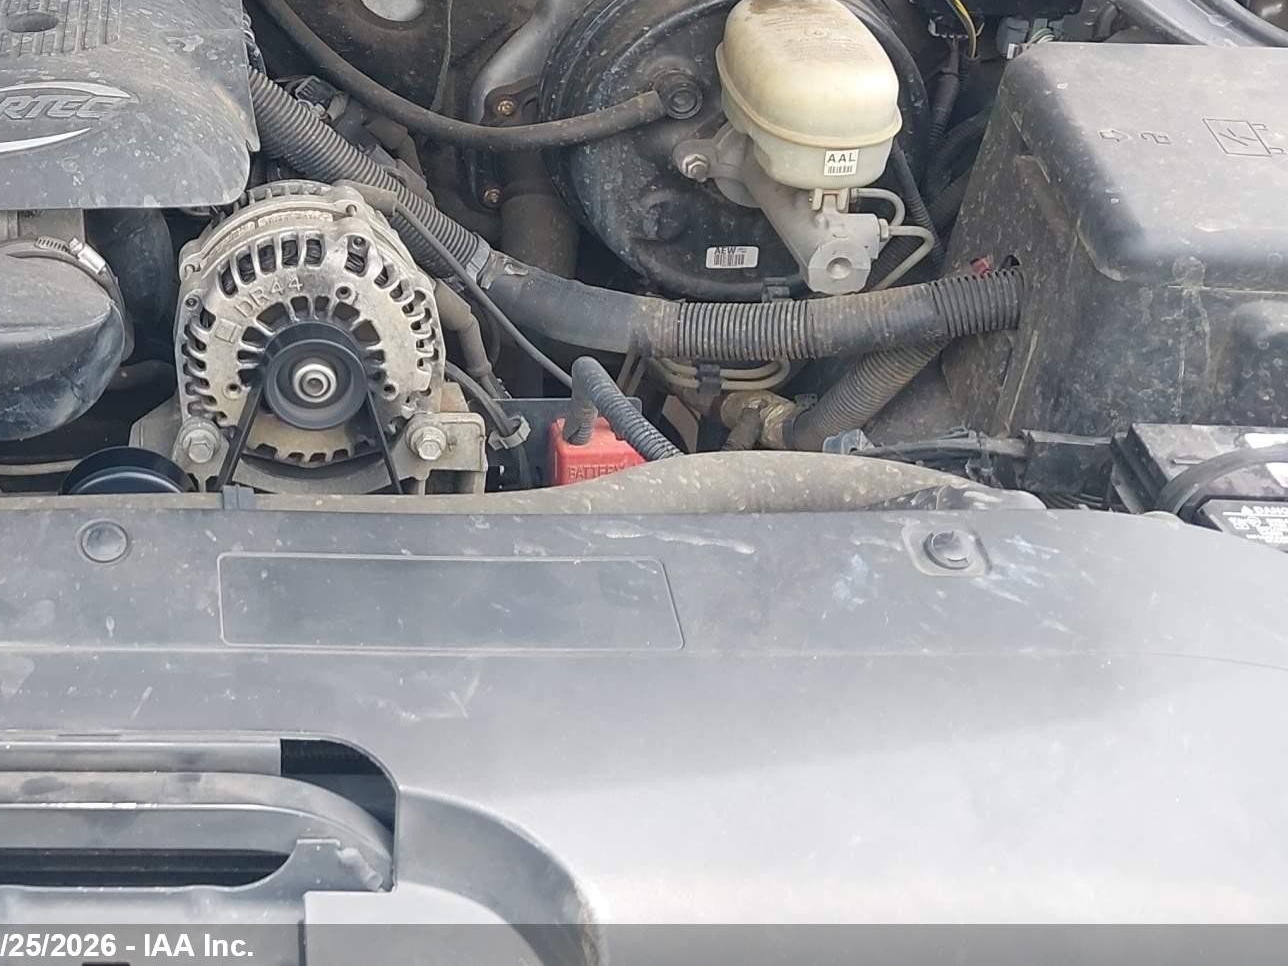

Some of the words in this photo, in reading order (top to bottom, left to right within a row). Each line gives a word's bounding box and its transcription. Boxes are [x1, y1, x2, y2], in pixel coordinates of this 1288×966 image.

[827, 152, 856, 163] AAL
[713, 245, 737, 255] AEW
[233, 272, 304, 319] DR44
